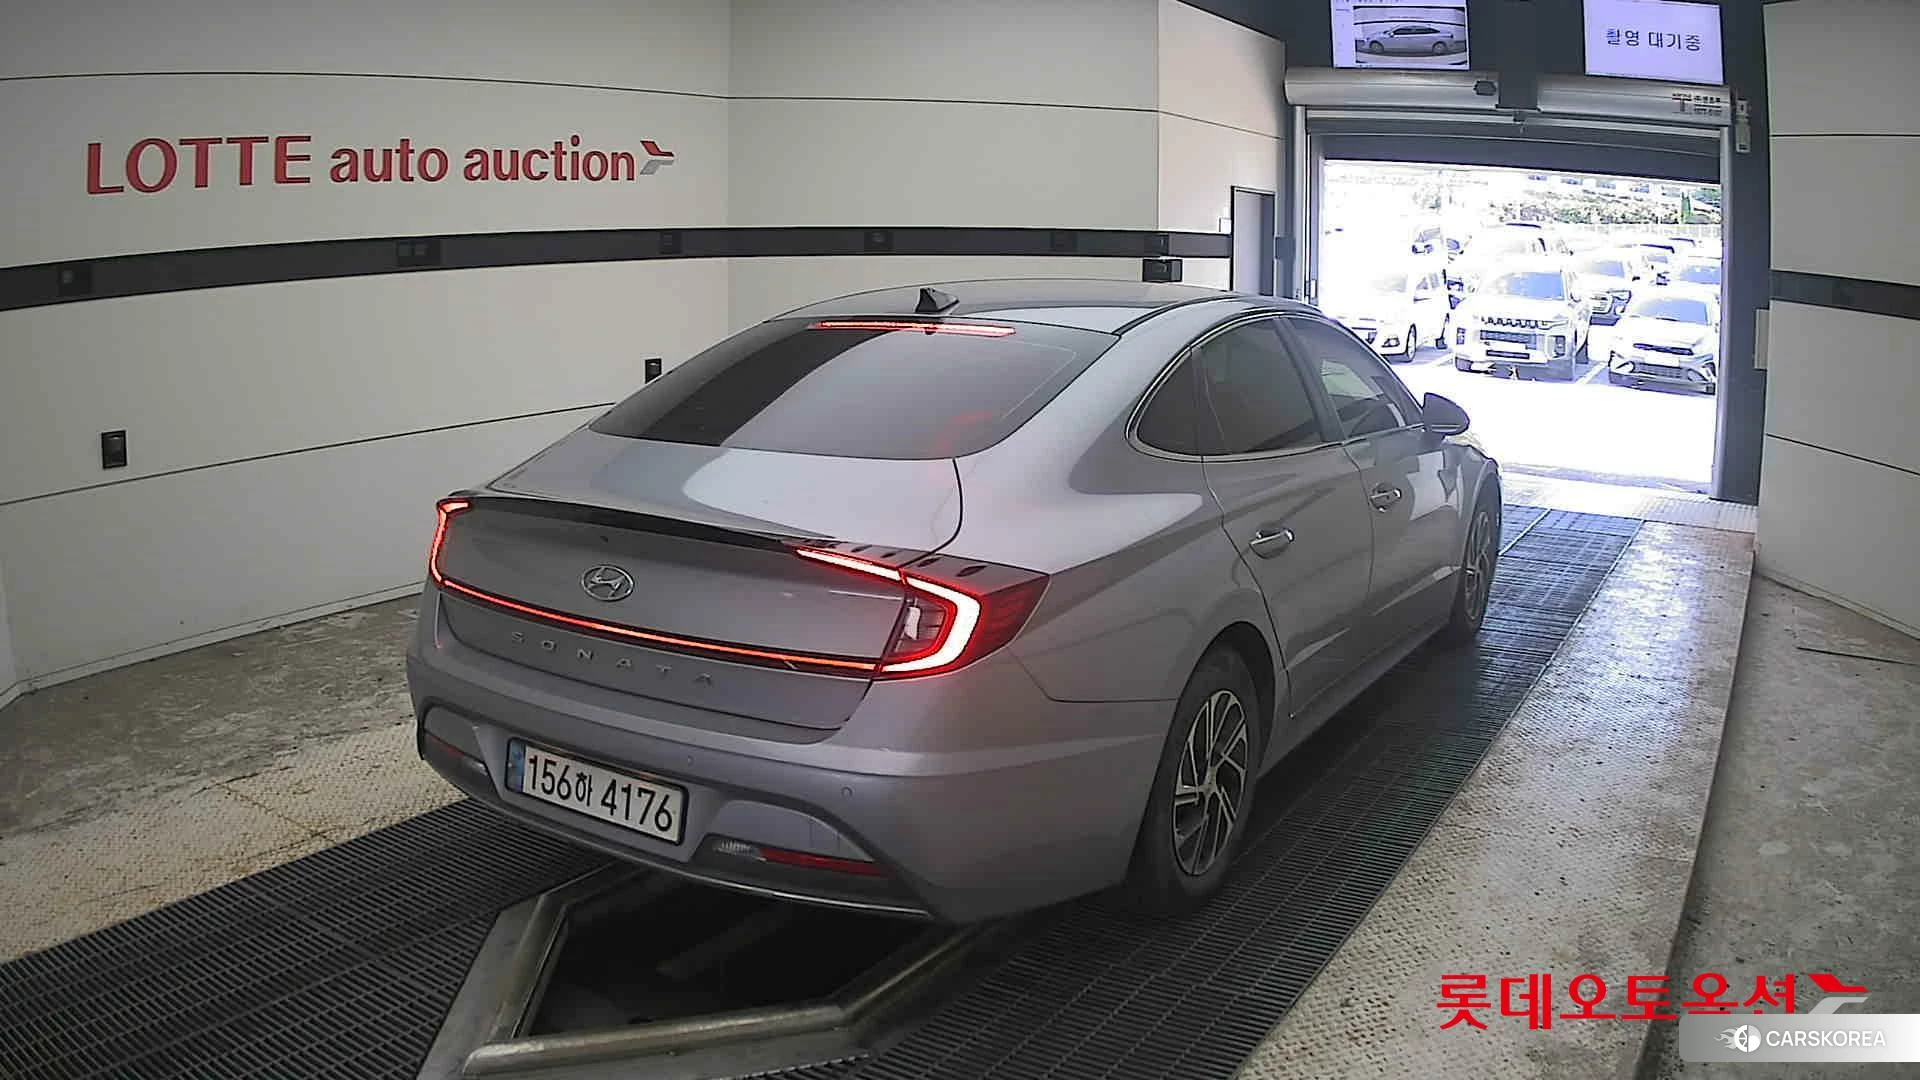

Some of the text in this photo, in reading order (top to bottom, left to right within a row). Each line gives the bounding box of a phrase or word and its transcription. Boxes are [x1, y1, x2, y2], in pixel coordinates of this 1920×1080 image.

[1648, 31, 1701, 51] 대기중
[87, 134, 636, 194] LOTTE auto auction
[511, 631, 712, 685] SONATA
[529, 755, 673, 832] 156하 4176
